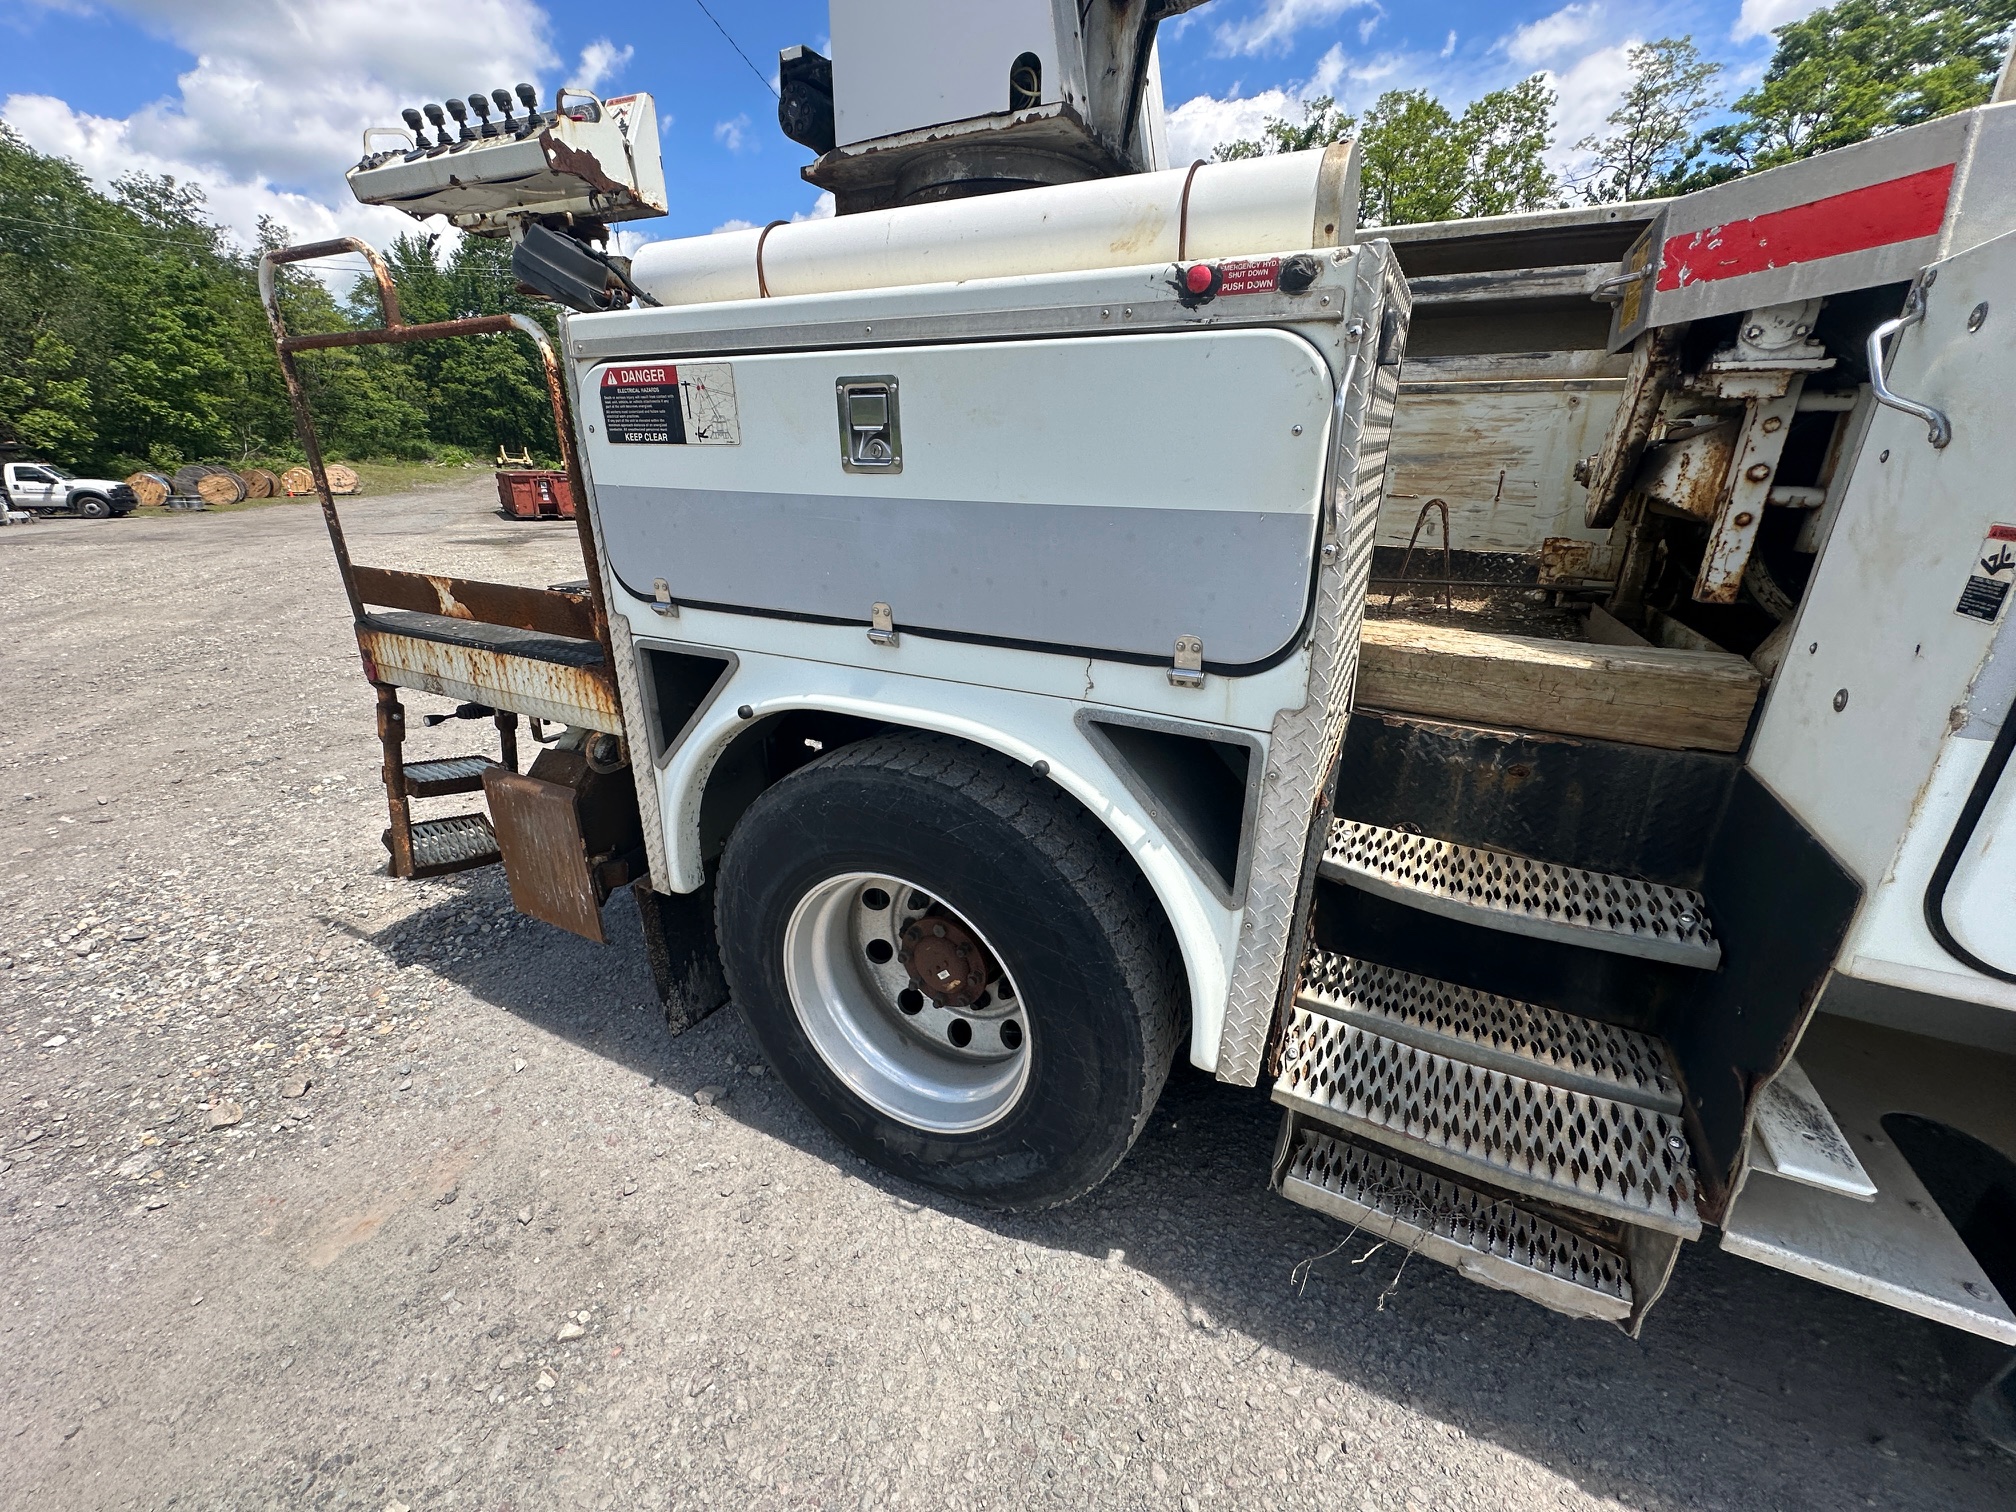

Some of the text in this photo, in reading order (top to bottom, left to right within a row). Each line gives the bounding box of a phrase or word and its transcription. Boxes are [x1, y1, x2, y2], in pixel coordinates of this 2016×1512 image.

[1228, 269, 1269, 279] SHUT DOWN
[1222, 280, 1273, 291] PUSH DOWN
[621, 369, 666, 383] DANGER
[625, 432, 668, 442] KEEP CLEAR
